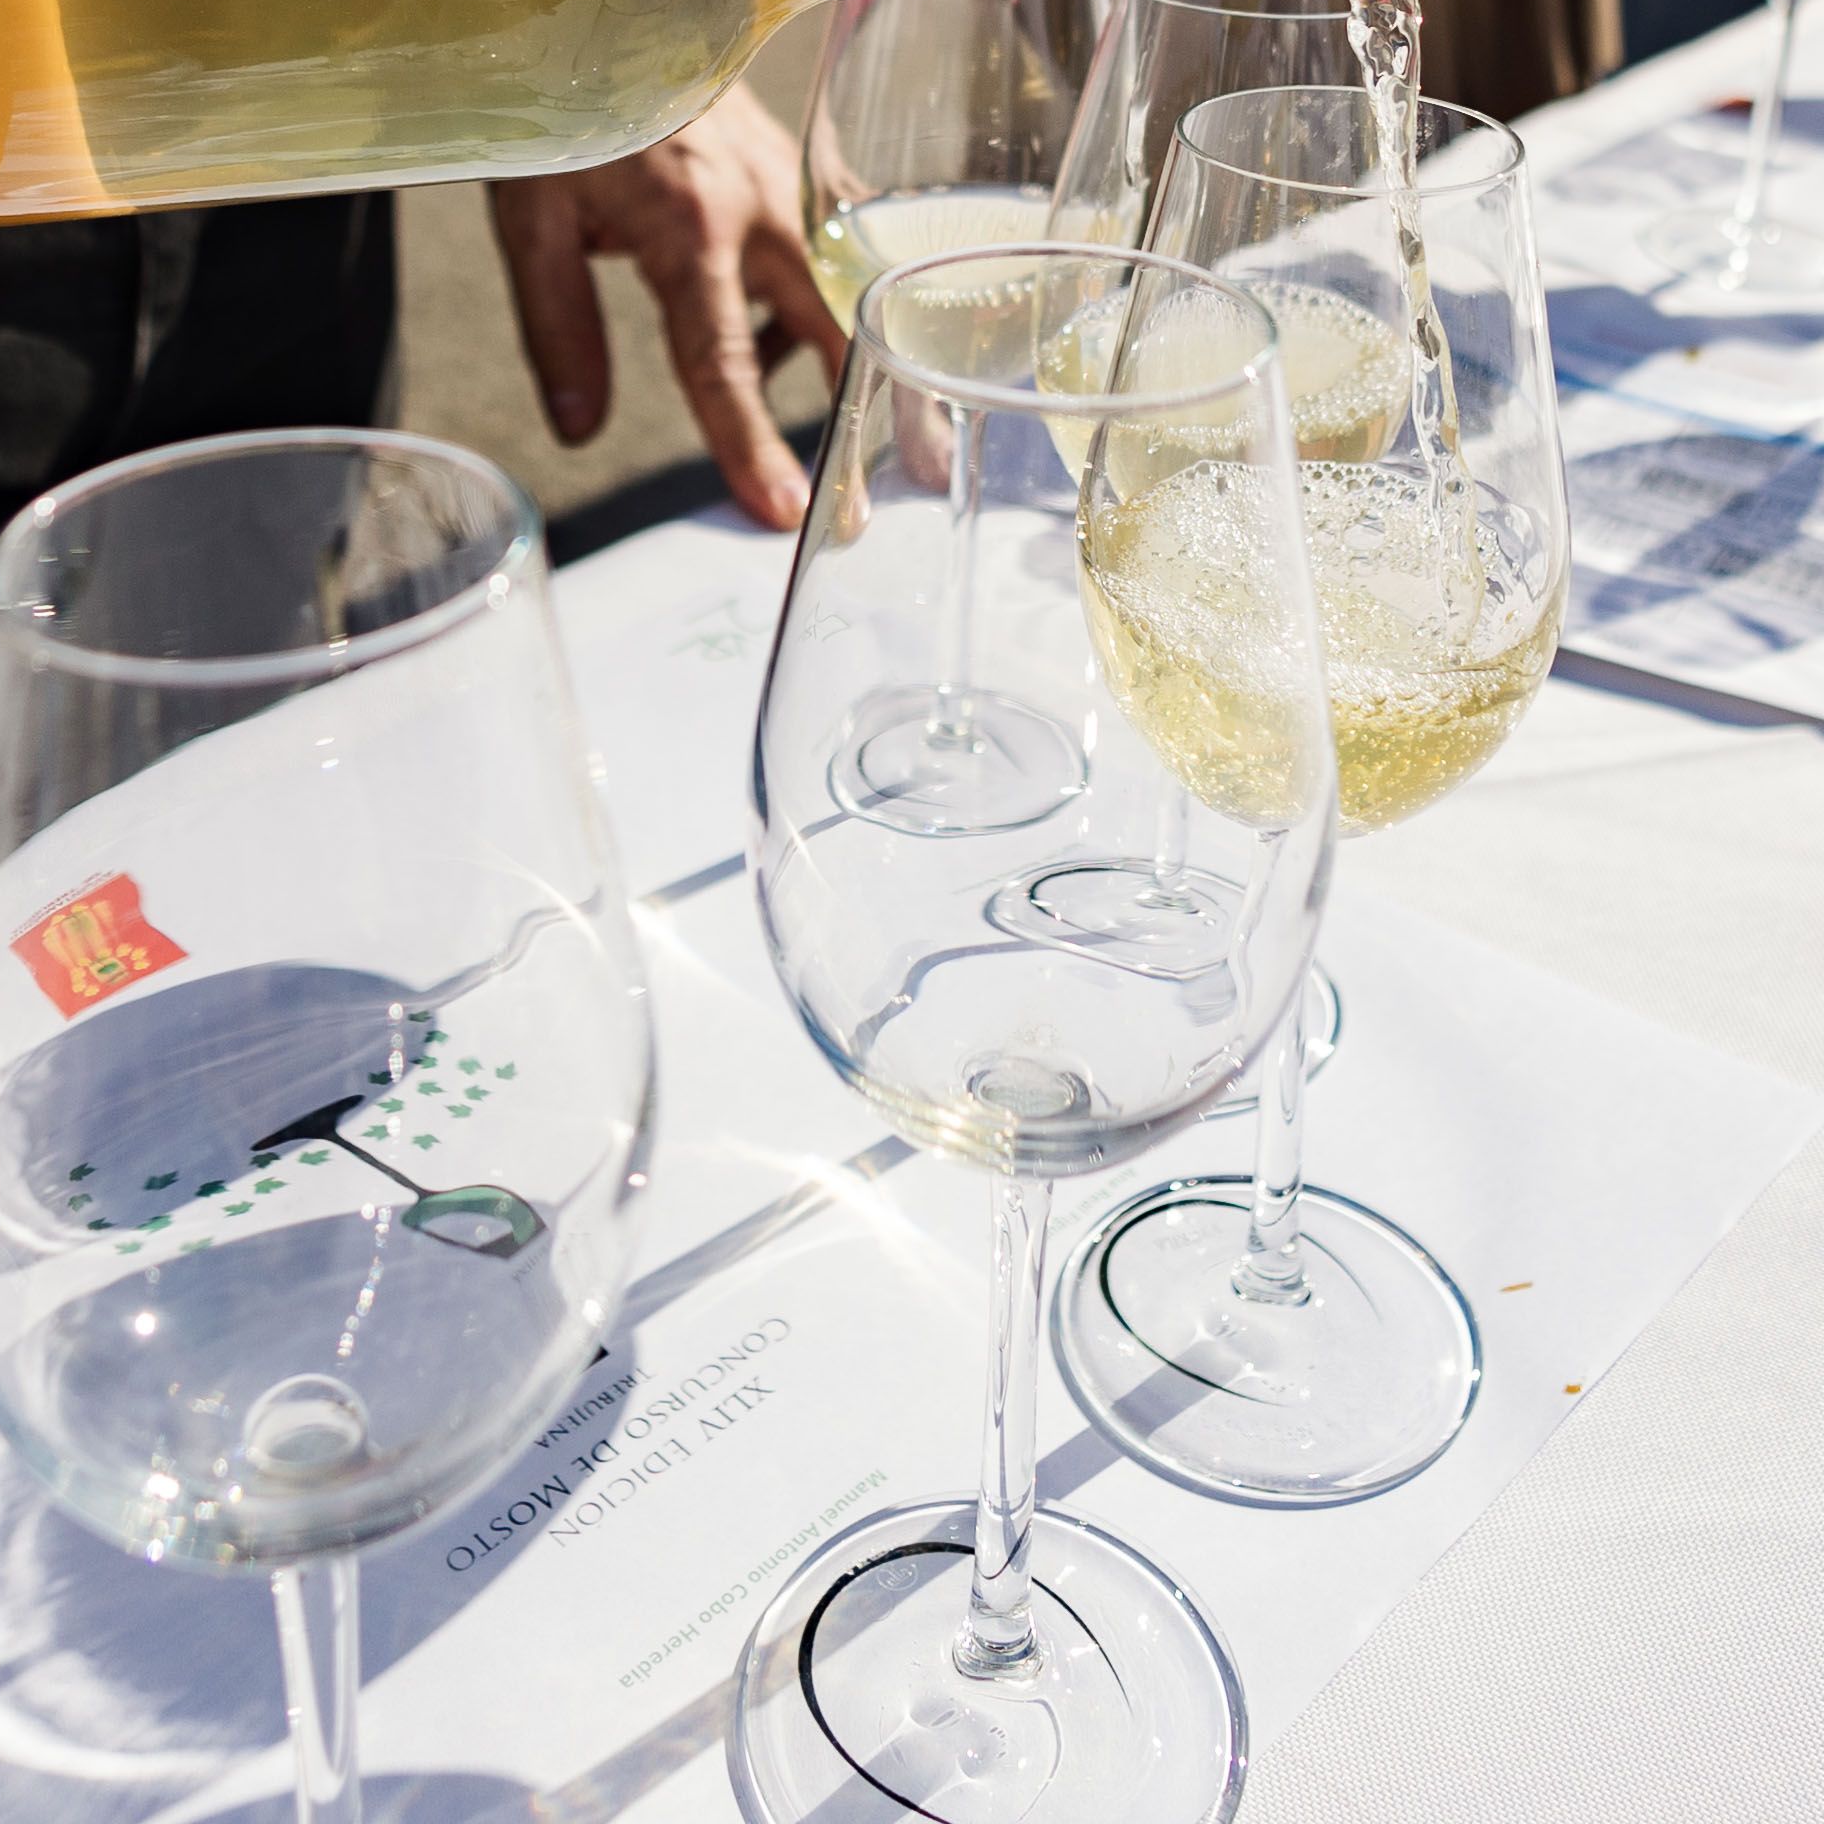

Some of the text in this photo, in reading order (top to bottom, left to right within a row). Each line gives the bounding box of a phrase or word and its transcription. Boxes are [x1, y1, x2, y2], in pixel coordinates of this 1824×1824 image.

[445, 1317, 792, 1573] CONCURSO DE MOSTO
[548, 1375, 776, 1549] XLIV EDICIÓN
[819, 1468, 889, 1528] Manuel
[747, 1523, 821, 1584] Antonio
[698, 1582, 749, 1626] Cobo
[618, 1622, 701, 1689] Heredia
